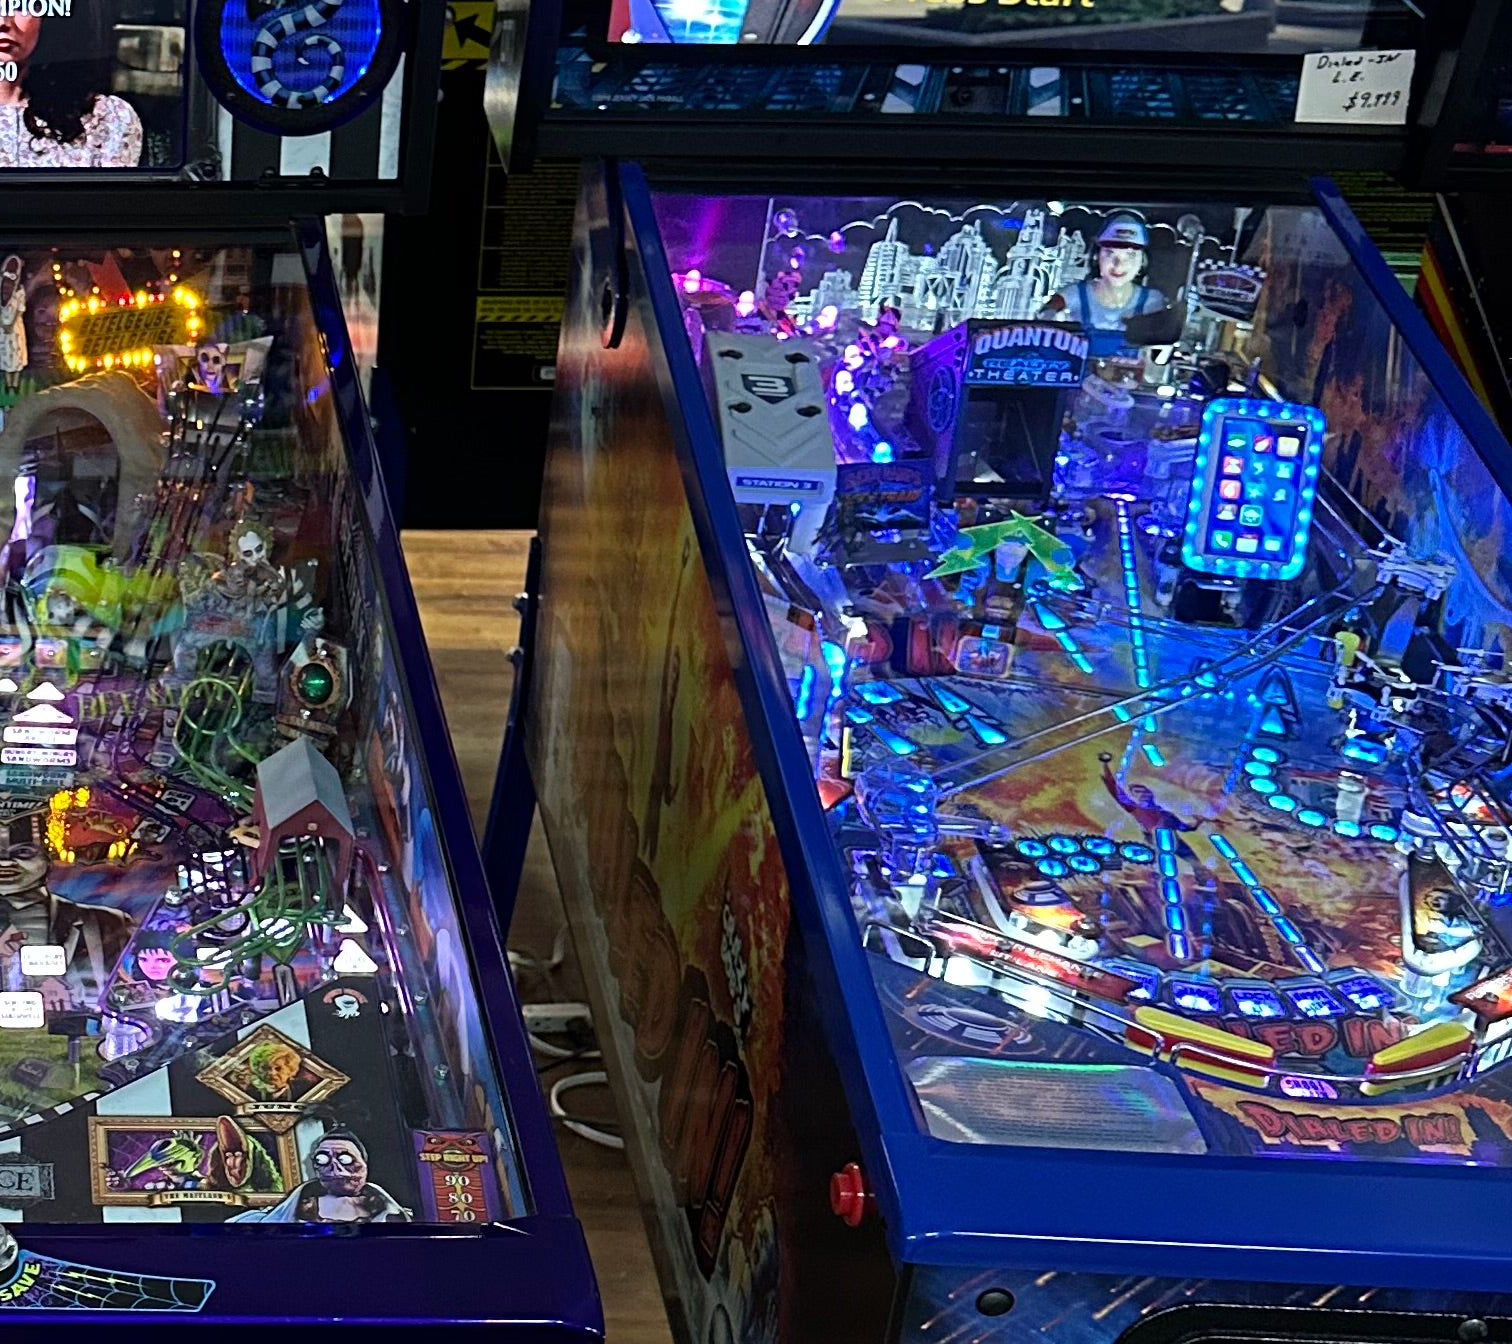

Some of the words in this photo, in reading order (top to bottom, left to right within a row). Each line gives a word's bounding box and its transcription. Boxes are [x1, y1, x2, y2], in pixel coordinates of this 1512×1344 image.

[974, 325, 1088, 357] QUANTUM
[974, 367, 1074, 382] THEATER
[750, 375, 789, 395] 3
[742, 479, 800, 489] STATION
[802, 481, 814, 490] 3
[1236, 1100, 1400, 1145] DIALED
[1401, 1113, 1464, 1146] IN!
[445, 1174, 471, 1188] 90
[448, 1191, 473, 1205] 80
[450, 1209, 476, 1222] 70
